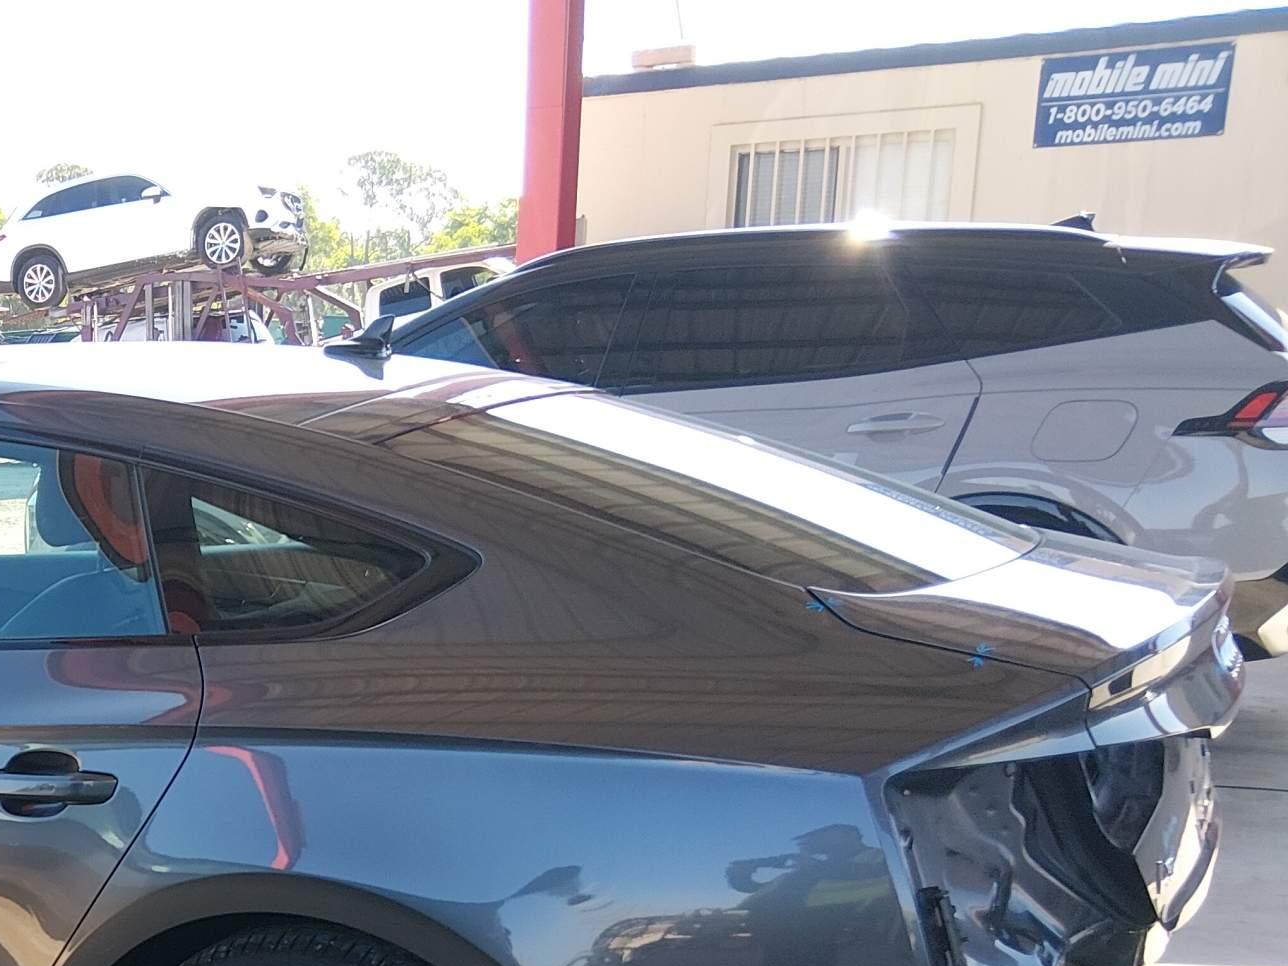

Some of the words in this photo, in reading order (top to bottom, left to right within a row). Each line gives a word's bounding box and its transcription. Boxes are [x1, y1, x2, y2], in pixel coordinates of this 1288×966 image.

[1043, 53, 1150, 98] mobile
[1149, 51, 1231, 90] mini
[1048, 94, 1214, 124] 1-800-950-6464
[1055, 120, 1202, 144] mobilemini.com
